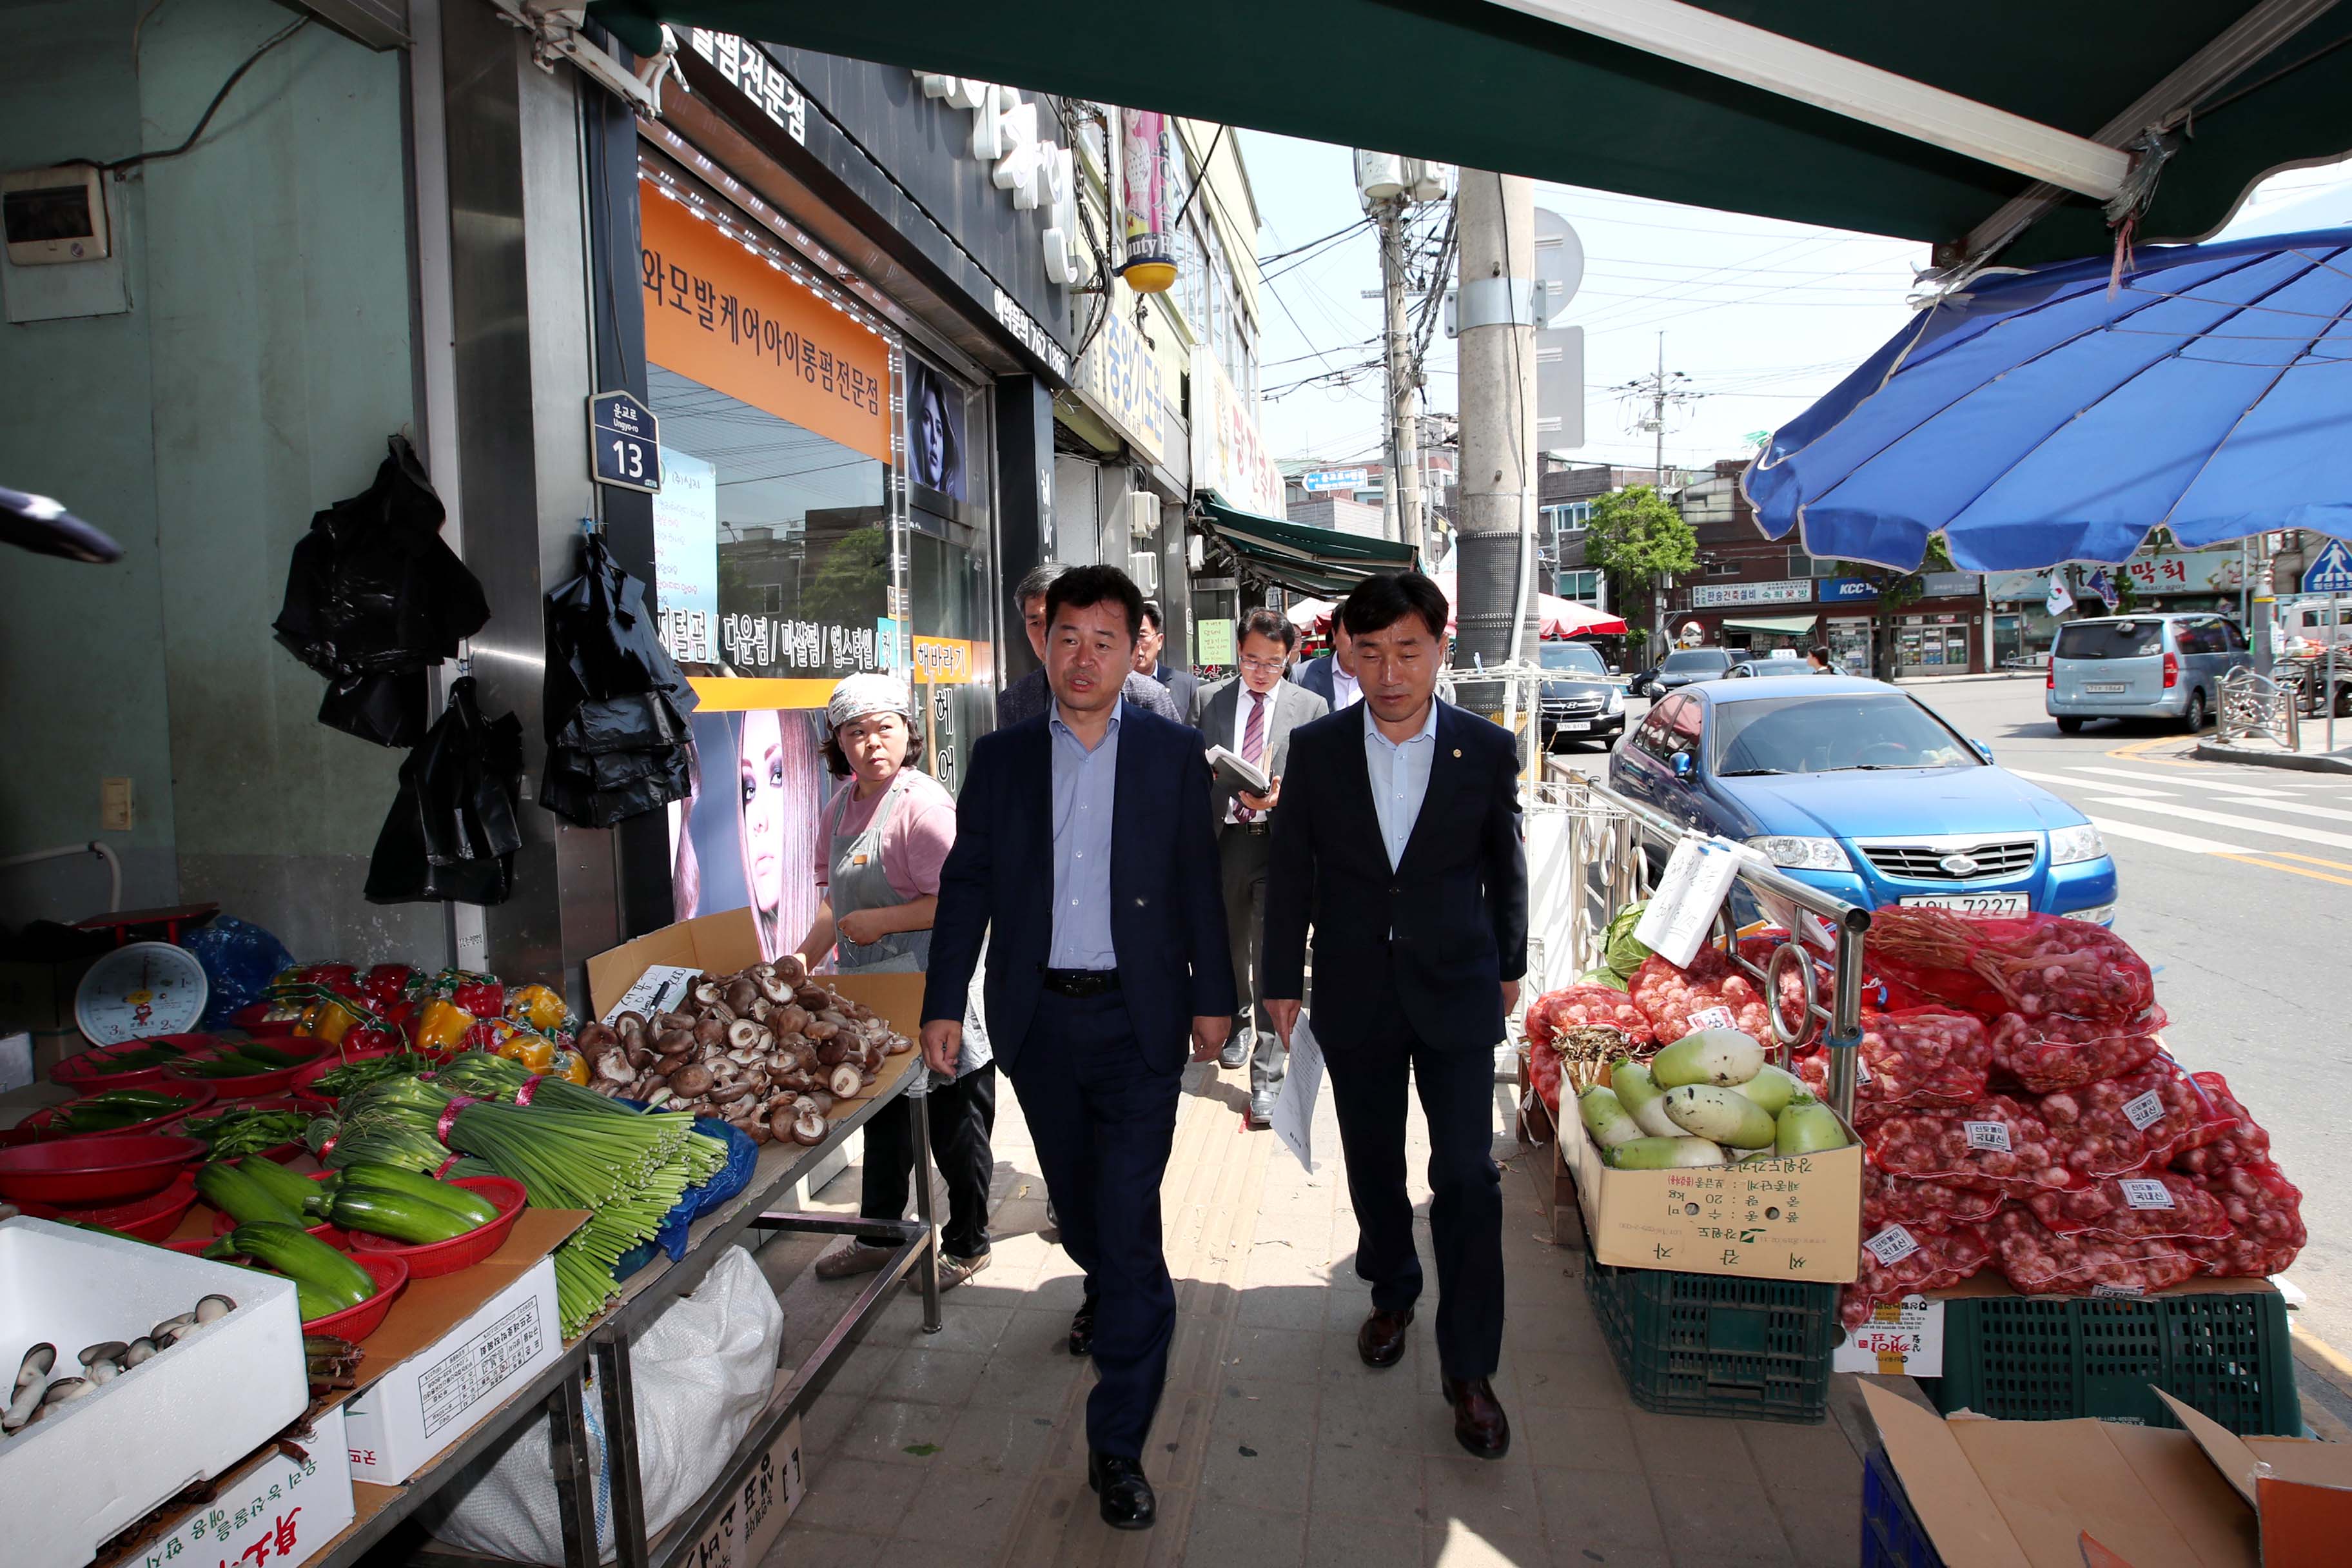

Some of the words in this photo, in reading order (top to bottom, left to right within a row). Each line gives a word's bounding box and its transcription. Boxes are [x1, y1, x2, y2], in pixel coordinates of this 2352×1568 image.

[994, 289, 1029, 348] 예약문의
[1031, 324, 1046, 362] 762
[1048, 343, 1066, 378] 1866
[613, 403, 638, 420] 운교로
[613, 418, 639, 433] Ungyo-ro
[613, 440, 643, 478] 13
[1041, 469, 1053, 563] 해바
[2131, 558, 2186, 583] 막회
[1839, 583, 1864, 594] KCC
[723, 613, 769, 666] 다운펌
[831, 625, 874, 670] 업스타일
[916, 643, 966, 676] 해바라기
[934, 688, 956, 792] 헤어
[1963, 898, 2017, 916] 7227
[1669, 1190, 1685, 1202] kg
[1747, 1180, 1800, 1191] 채종단계
[1705, 1194, 1723, 1204] 20
[1697, 1227, 1737, 1240] 강원도
[214, 1484, 282, 1543] 농산물을
